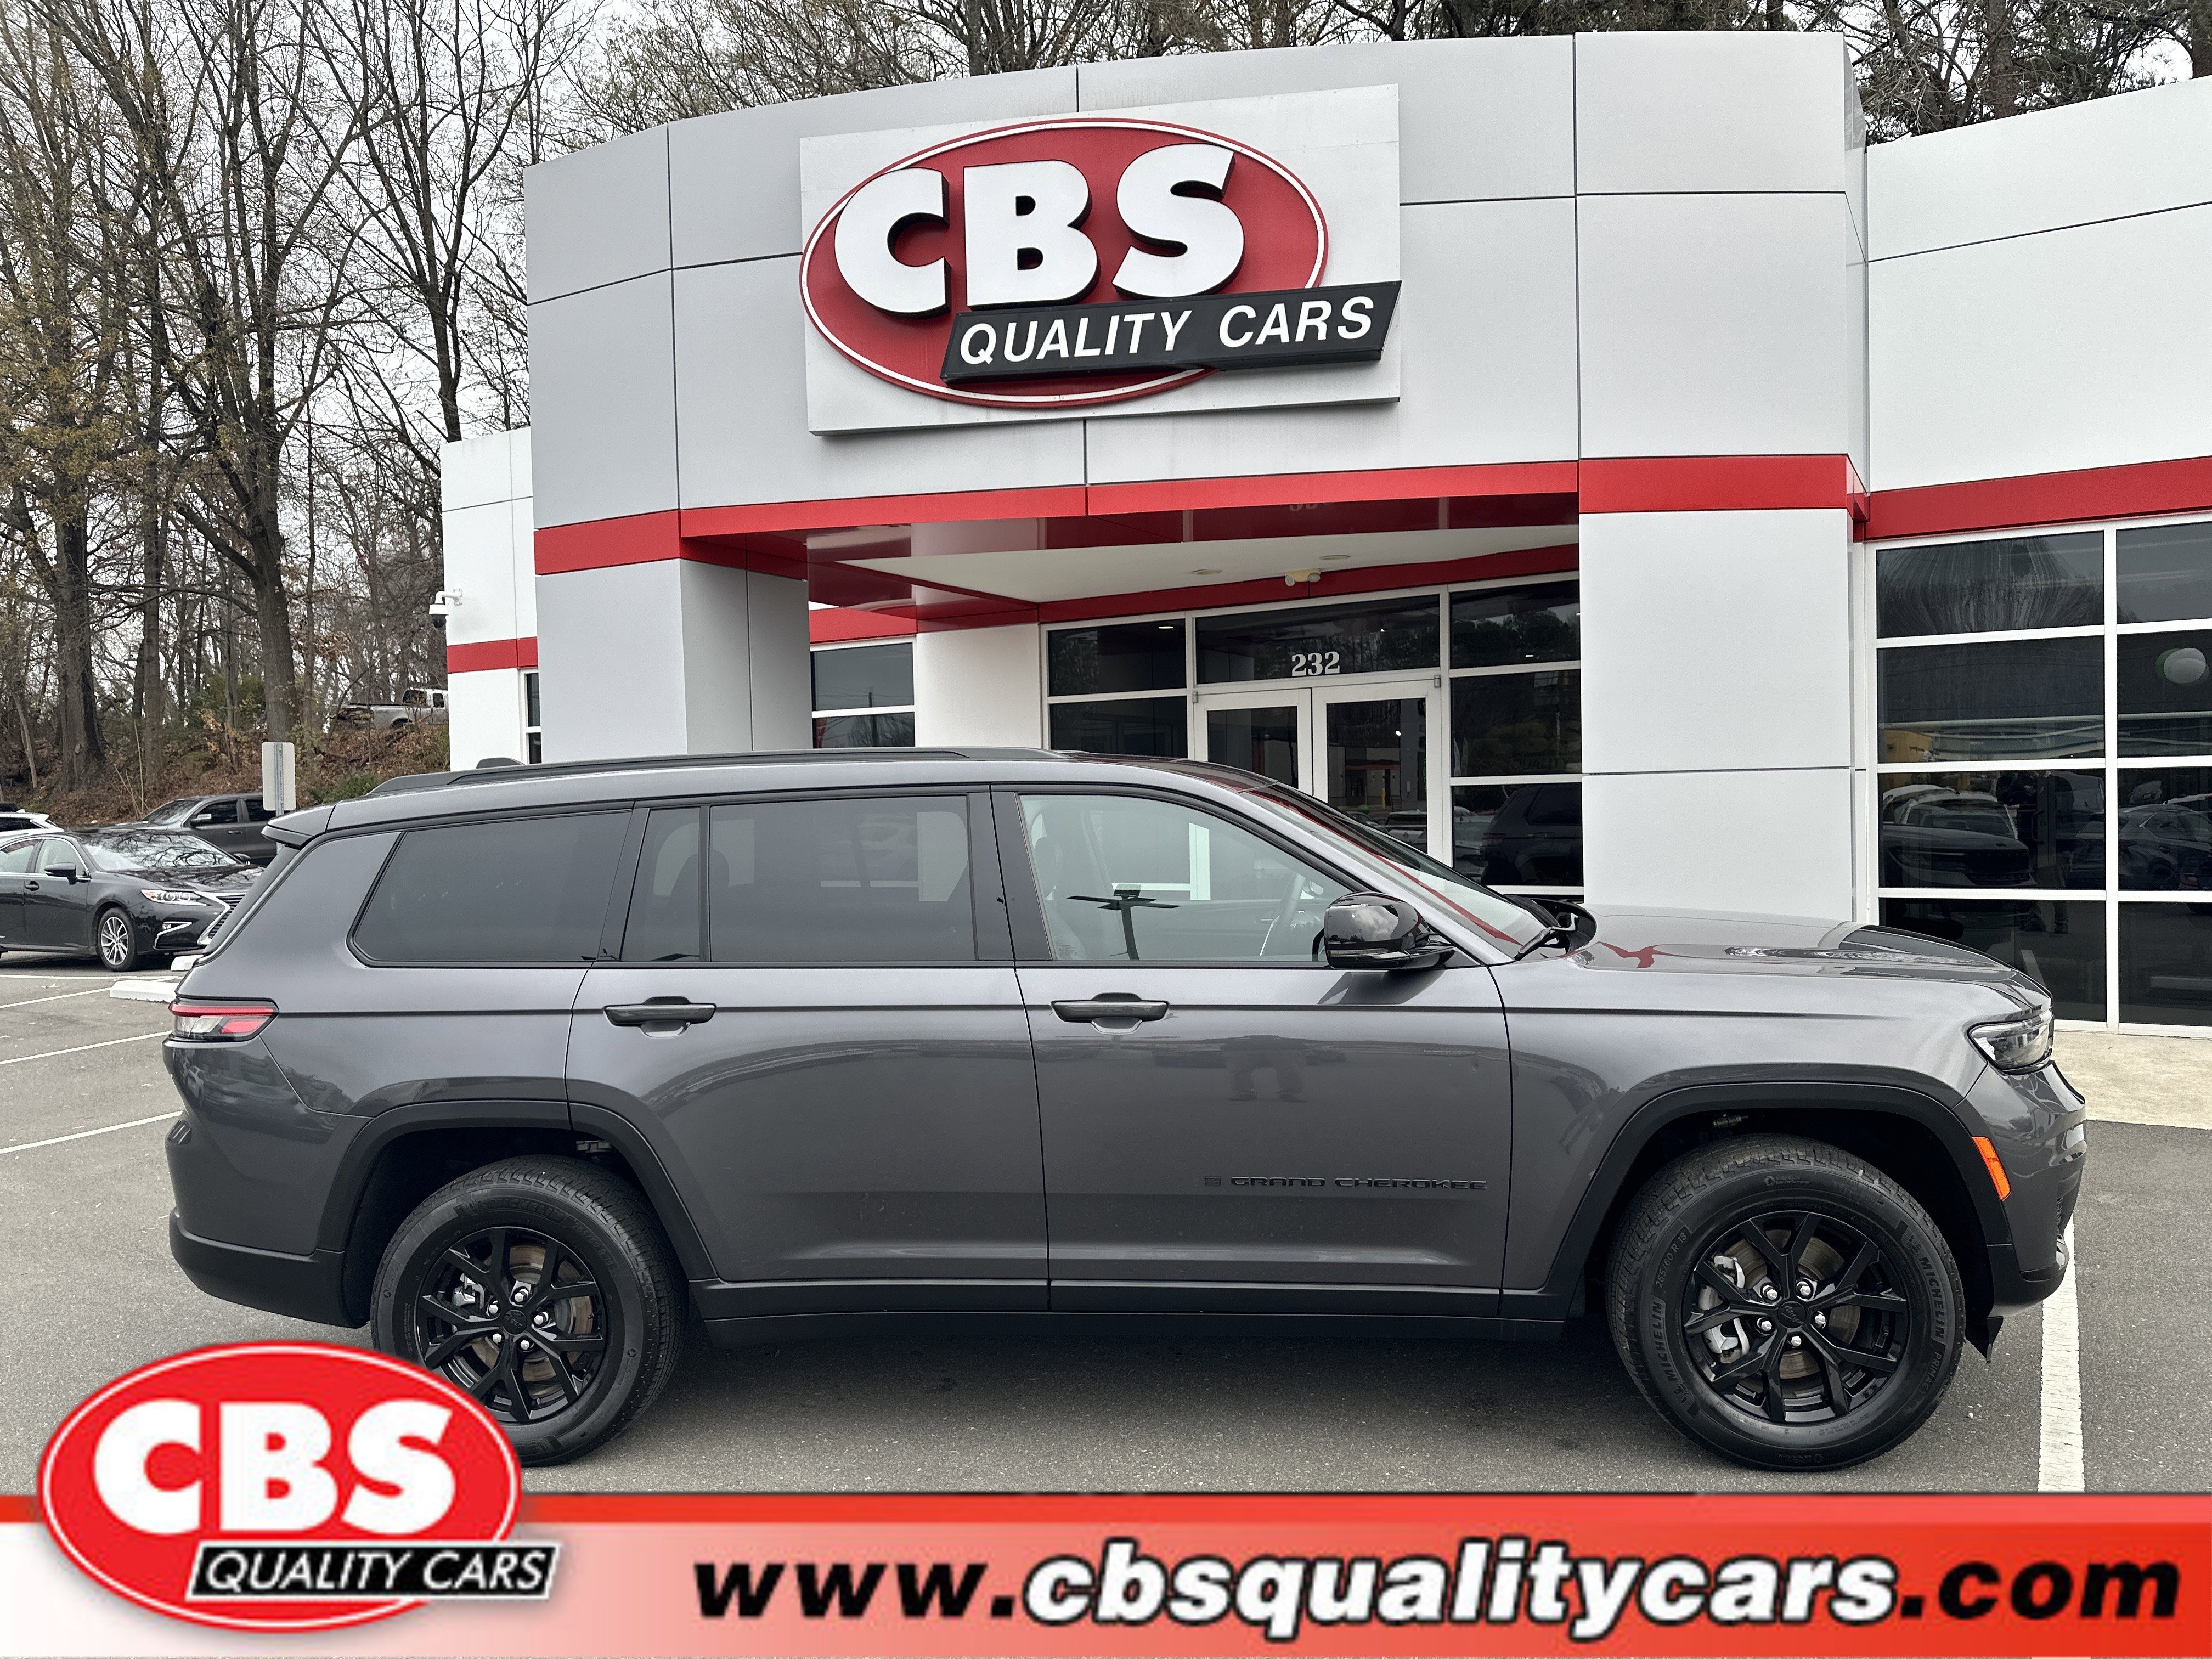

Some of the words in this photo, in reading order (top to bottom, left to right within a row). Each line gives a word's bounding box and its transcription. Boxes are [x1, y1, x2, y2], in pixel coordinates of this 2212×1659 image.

[834, 143, 1245, 315] CBS
[959, 309, 1193, 365] QUALITY
[1218, 295, 1374, 348] CARS
[1291, 651, 1340, 677] 232
[1231, 1177, 1325, 1187] GRAND
[1335, 1178, 1488, 1190] CHEROKEE
[1655, 1252, 1674, 1289] 265/60
[1671, 1244, 1680, 1252] R
[1677, 1232, 1688, 1244] 18
[1918, 1256, 1946, 1339] MICHELIN
[1652, 1301, 1678, 1382] MICHELIN
